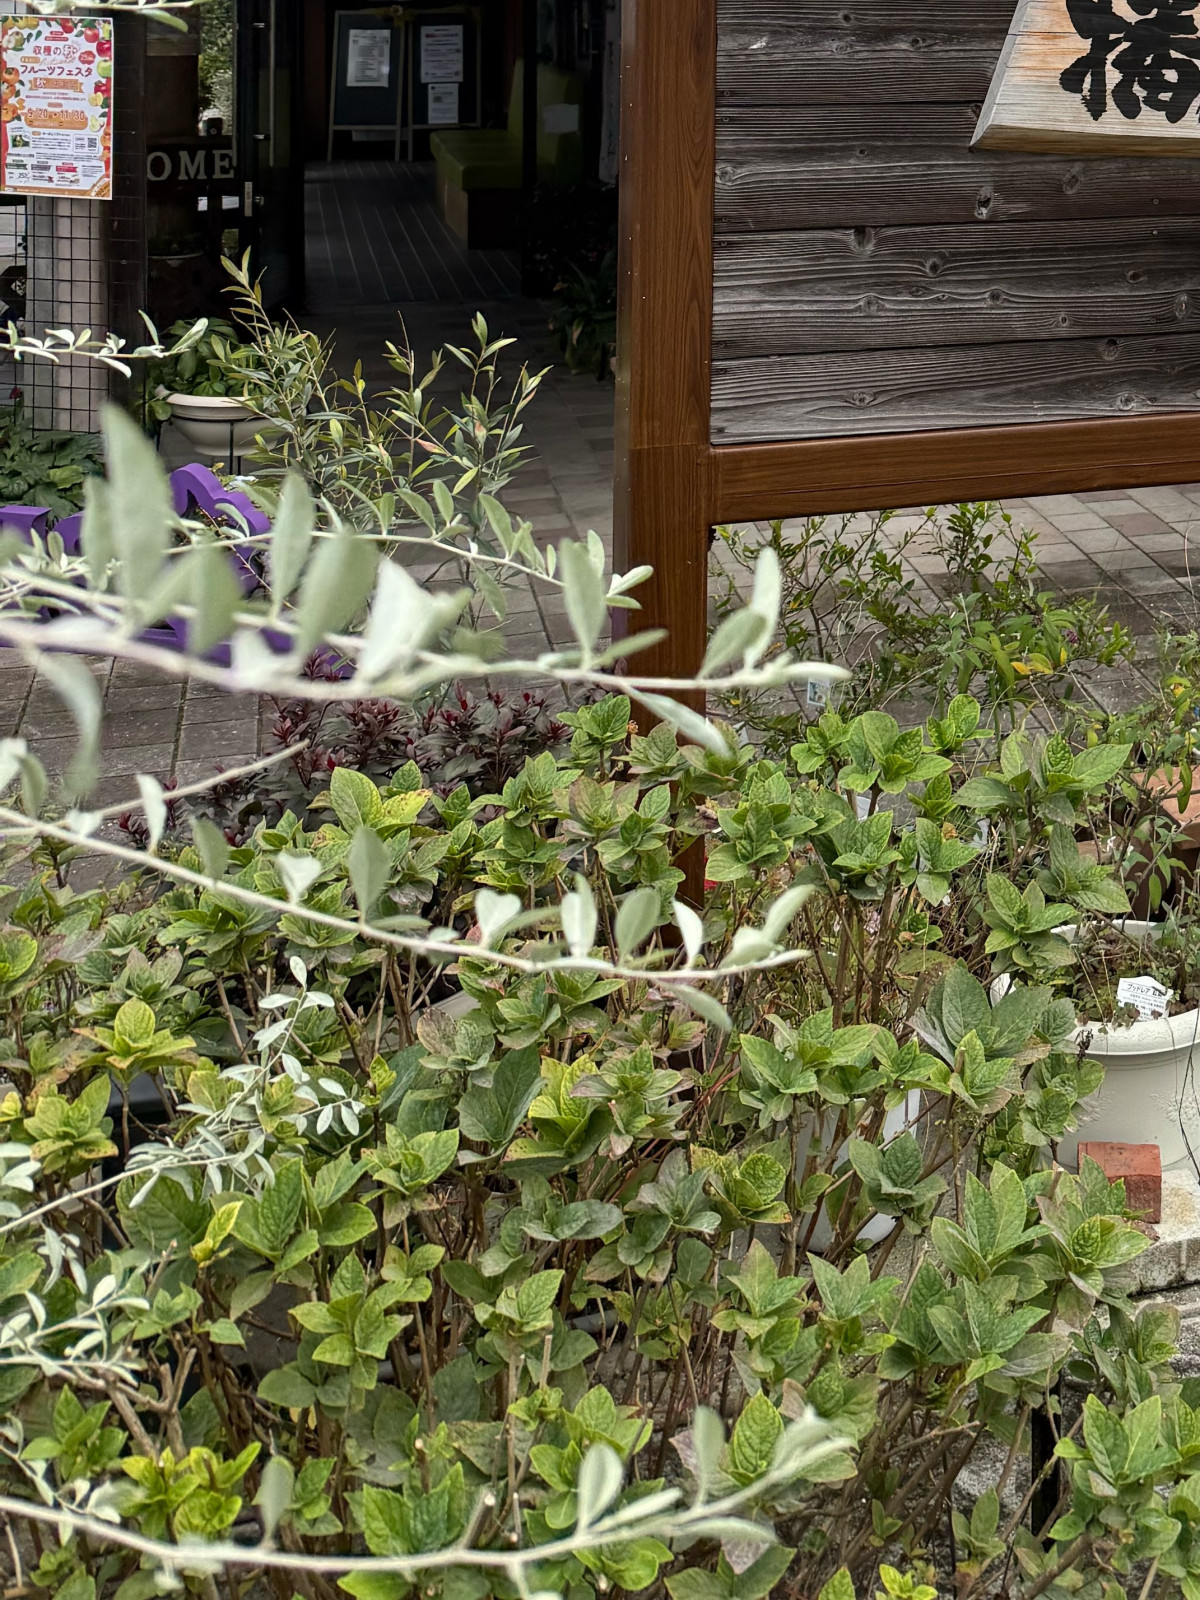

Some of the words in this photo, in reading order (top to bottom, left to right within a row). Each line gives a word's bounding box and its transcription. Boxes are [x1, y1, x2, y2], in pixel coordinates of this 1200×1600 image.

[20, 64, 93, 78] フルーツフェスタ
